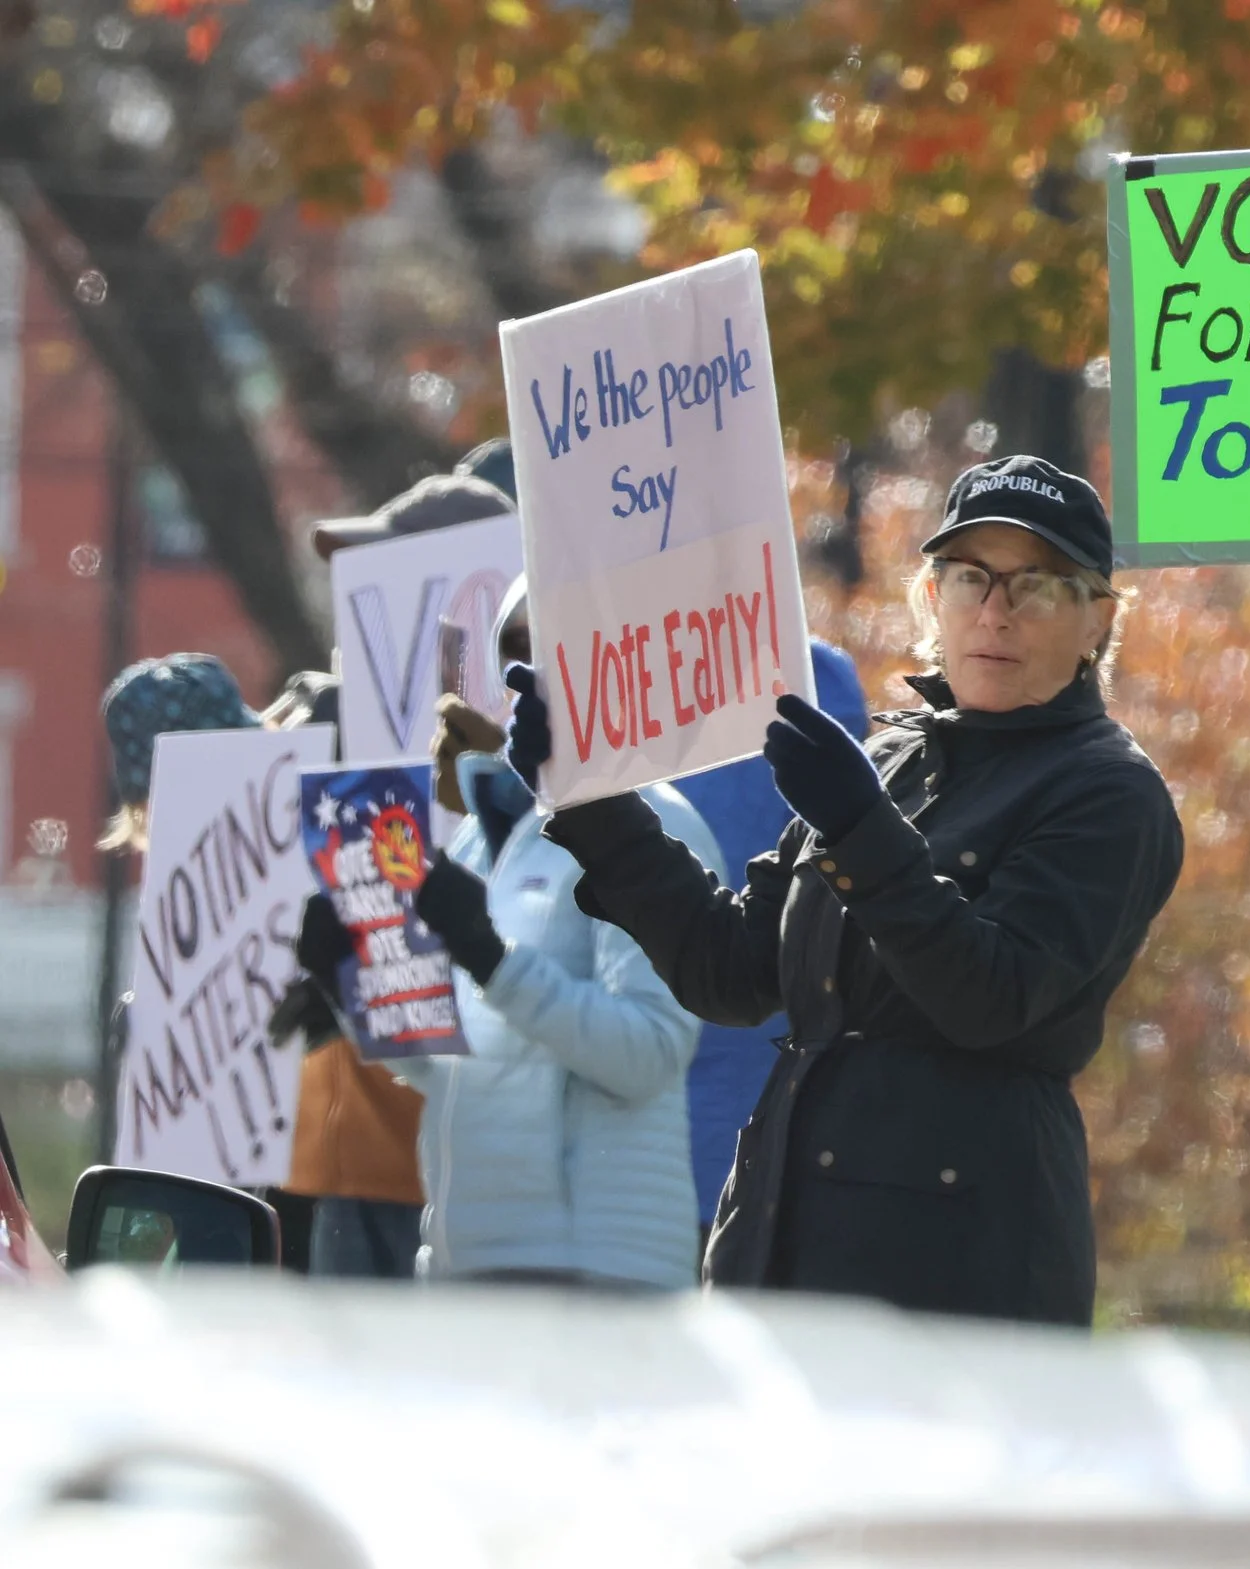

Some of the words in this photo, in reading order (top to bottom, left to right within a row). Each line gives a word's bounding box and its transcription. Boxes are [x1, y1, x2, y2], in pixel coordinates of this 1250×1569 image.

[530, 364, 592, 460] We
[593, 348, 655, 428] the
[658, 317, 756, 448] people
[967, 474, 1066, 504] PROPUBLICA
[140, 750, 301, 999] VOTING
[132, 900, 300, 1161] MATTERS
